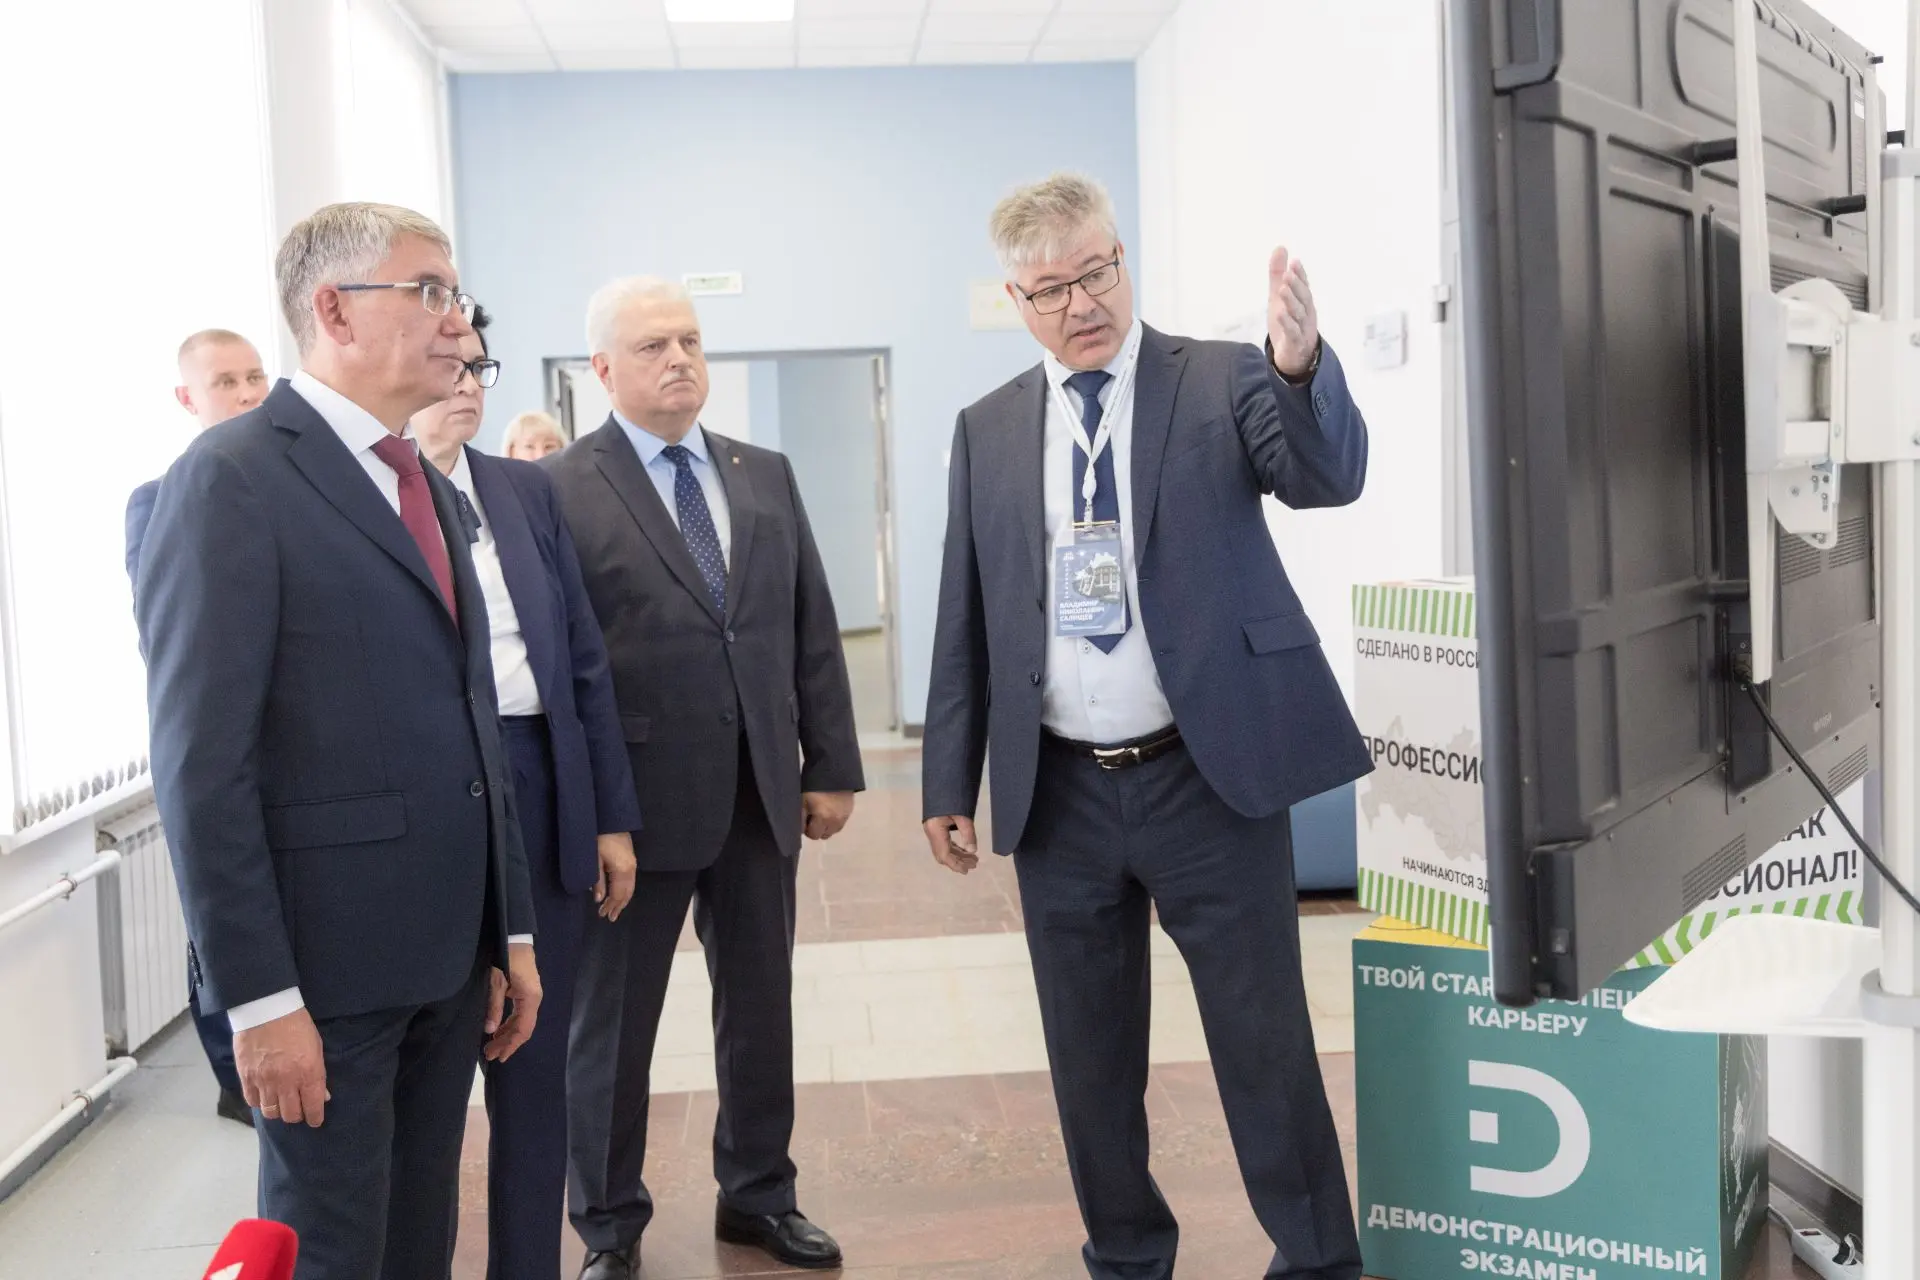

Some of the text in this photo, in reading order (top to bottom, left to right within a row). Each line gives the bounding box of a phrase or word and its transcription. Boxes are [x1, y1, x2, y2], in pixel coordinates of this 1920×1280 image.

[1356, 637, 1420, 662] СДЕЛАНО
[1424, 645, 1433, 663] В
[1361, 735, 1485, 785] ПРОФЕССИ
[1402, 856, 1474, 889] НАЧИНАЮТСЯ
[1358, 964, 1425, 991] ТВОЙ
[1467, 1005, 1588, 1037] КАРЬЕРУ
[1367, 1203, 1708, 1276] ДЕМОНСТРАЦИОННЫЙ
